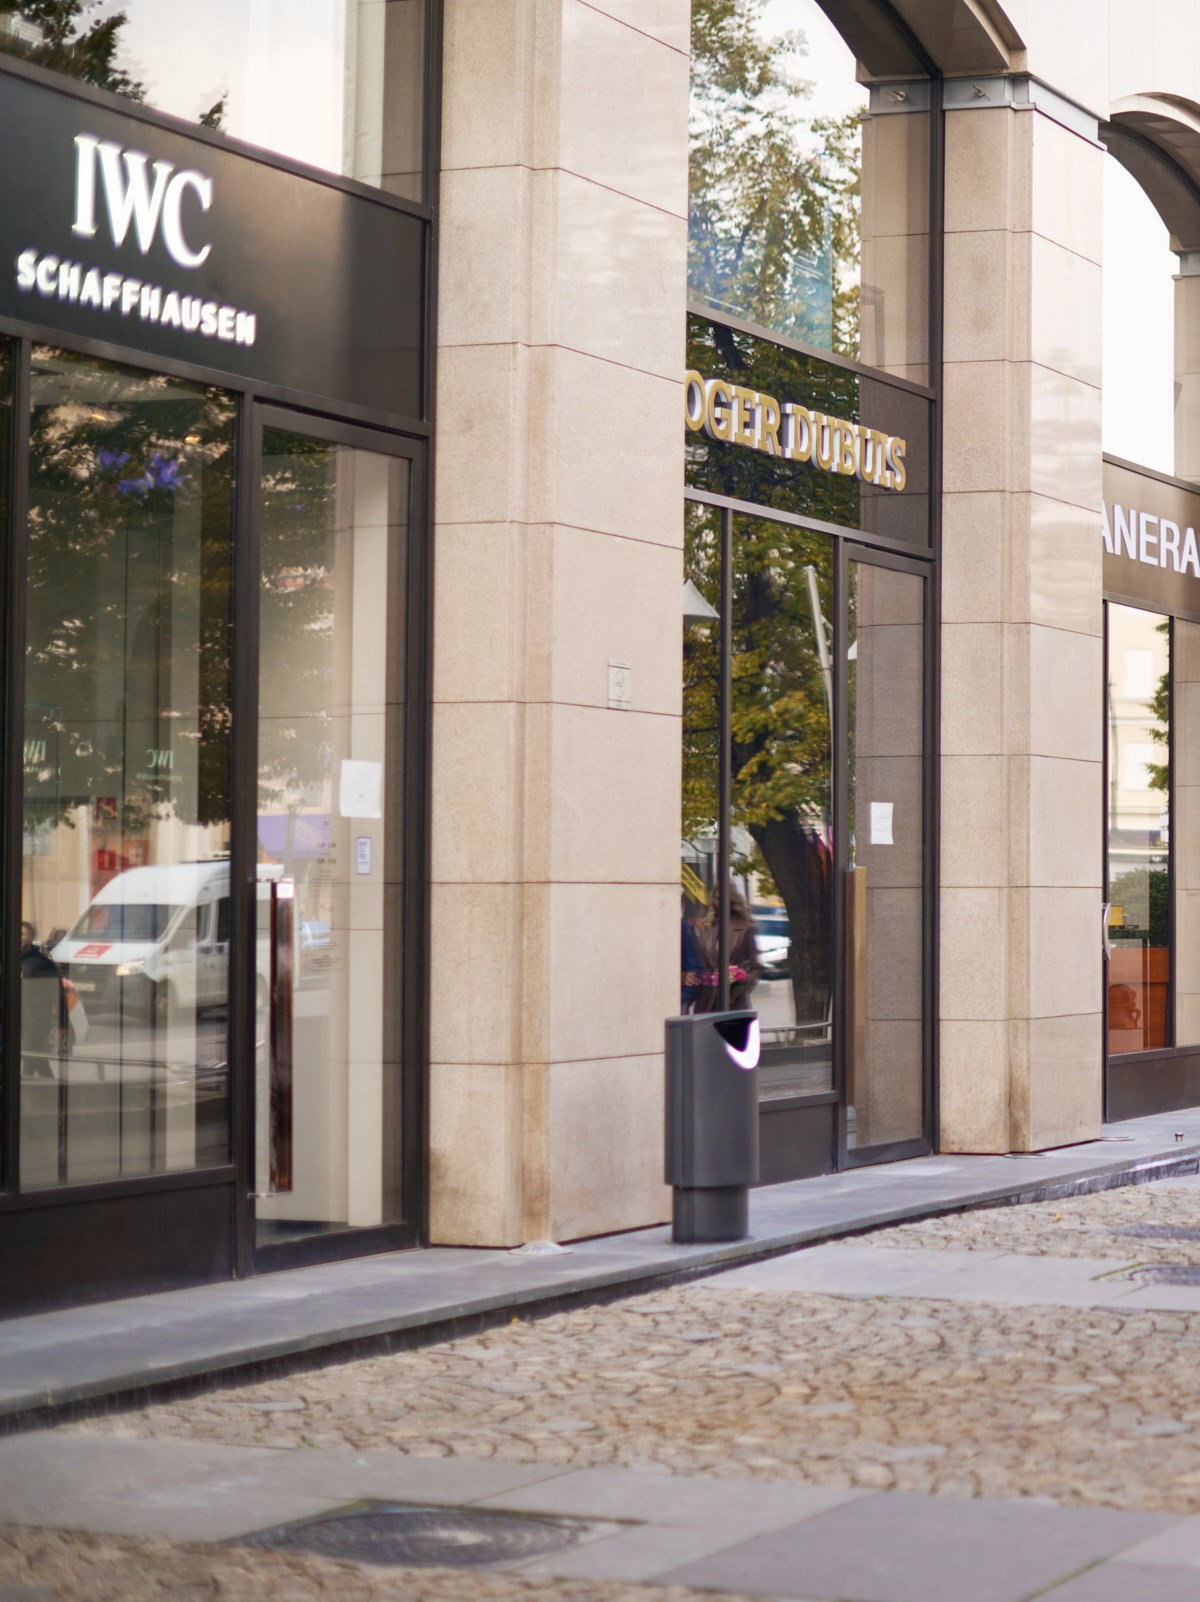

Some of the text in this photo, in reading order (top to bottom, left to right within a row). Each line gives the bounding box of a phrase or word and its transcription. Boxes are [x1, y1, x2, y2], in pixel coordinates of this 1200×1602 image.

[71, 134, 213, 268] IWC
[17, 249, 256, 346] SCHAFFHAUSEN
[685, 369, 906, 491] OGER DUBUIS
